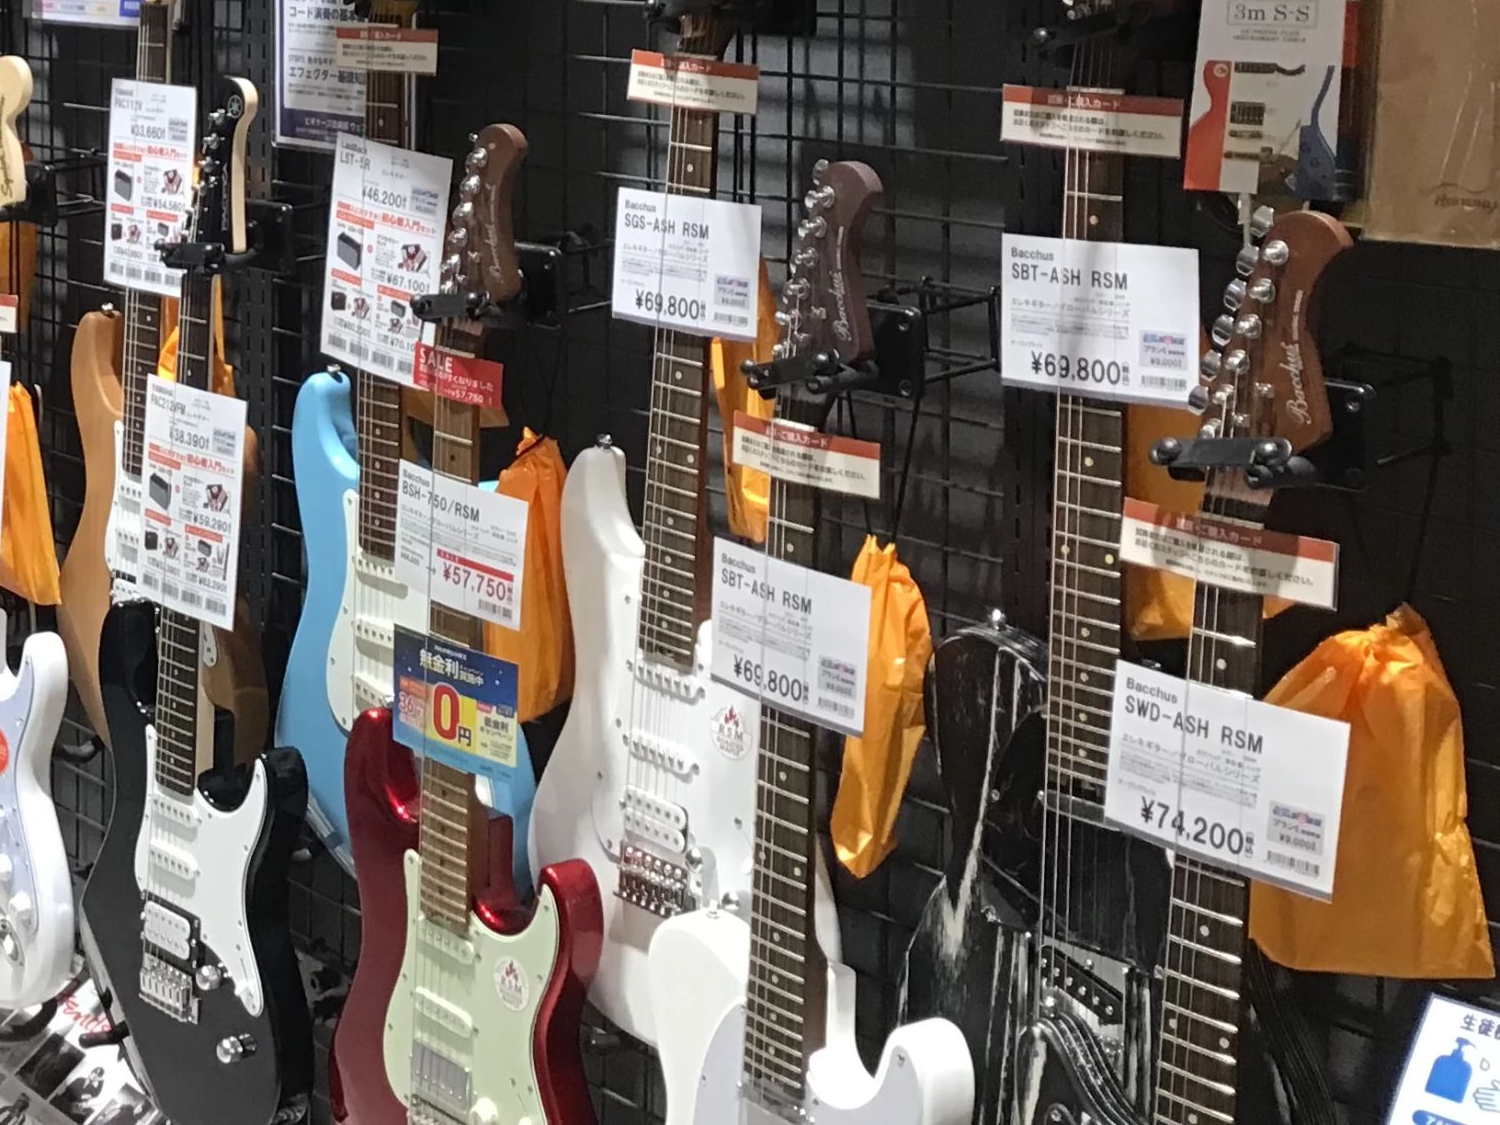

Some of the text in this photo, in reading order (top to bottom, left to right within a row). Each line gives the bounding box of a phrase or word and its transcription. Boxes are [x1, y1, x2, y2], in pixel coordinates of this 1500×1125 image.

[289, 6, 366, 22] コード演奏の基本
[1235, 3, 1310, 23] 3m S-S
[624, 199, 657, 213] Bacchus
[624, 213, 710, 240] SGS-ASH RSM
[1011, 246, 1055, 262] Bacchus
[1011, 262, 1128, 291] SBT-ASH RSM
[635, 288, 700, 320] ¥69,800
[419, 346, 453, 373] SALE
[1031, 350, 1121, 386] ¥69,800
[402, 480, 480, 523] BSH-750/RSM
[721, 552, 756, 575] Bacchus
[442, 561, 506, 601] ¥57,750
[721, 568, 813, 615] SBT-ASH RSM
[733, 654, 802, 702] ¥69,800
[1125, 676, 1178, 705] Bacchus
[1124, 694, 1264, 754] SWD-ASH RSM
[1140, 796, 1244, 855] ¥74,200
